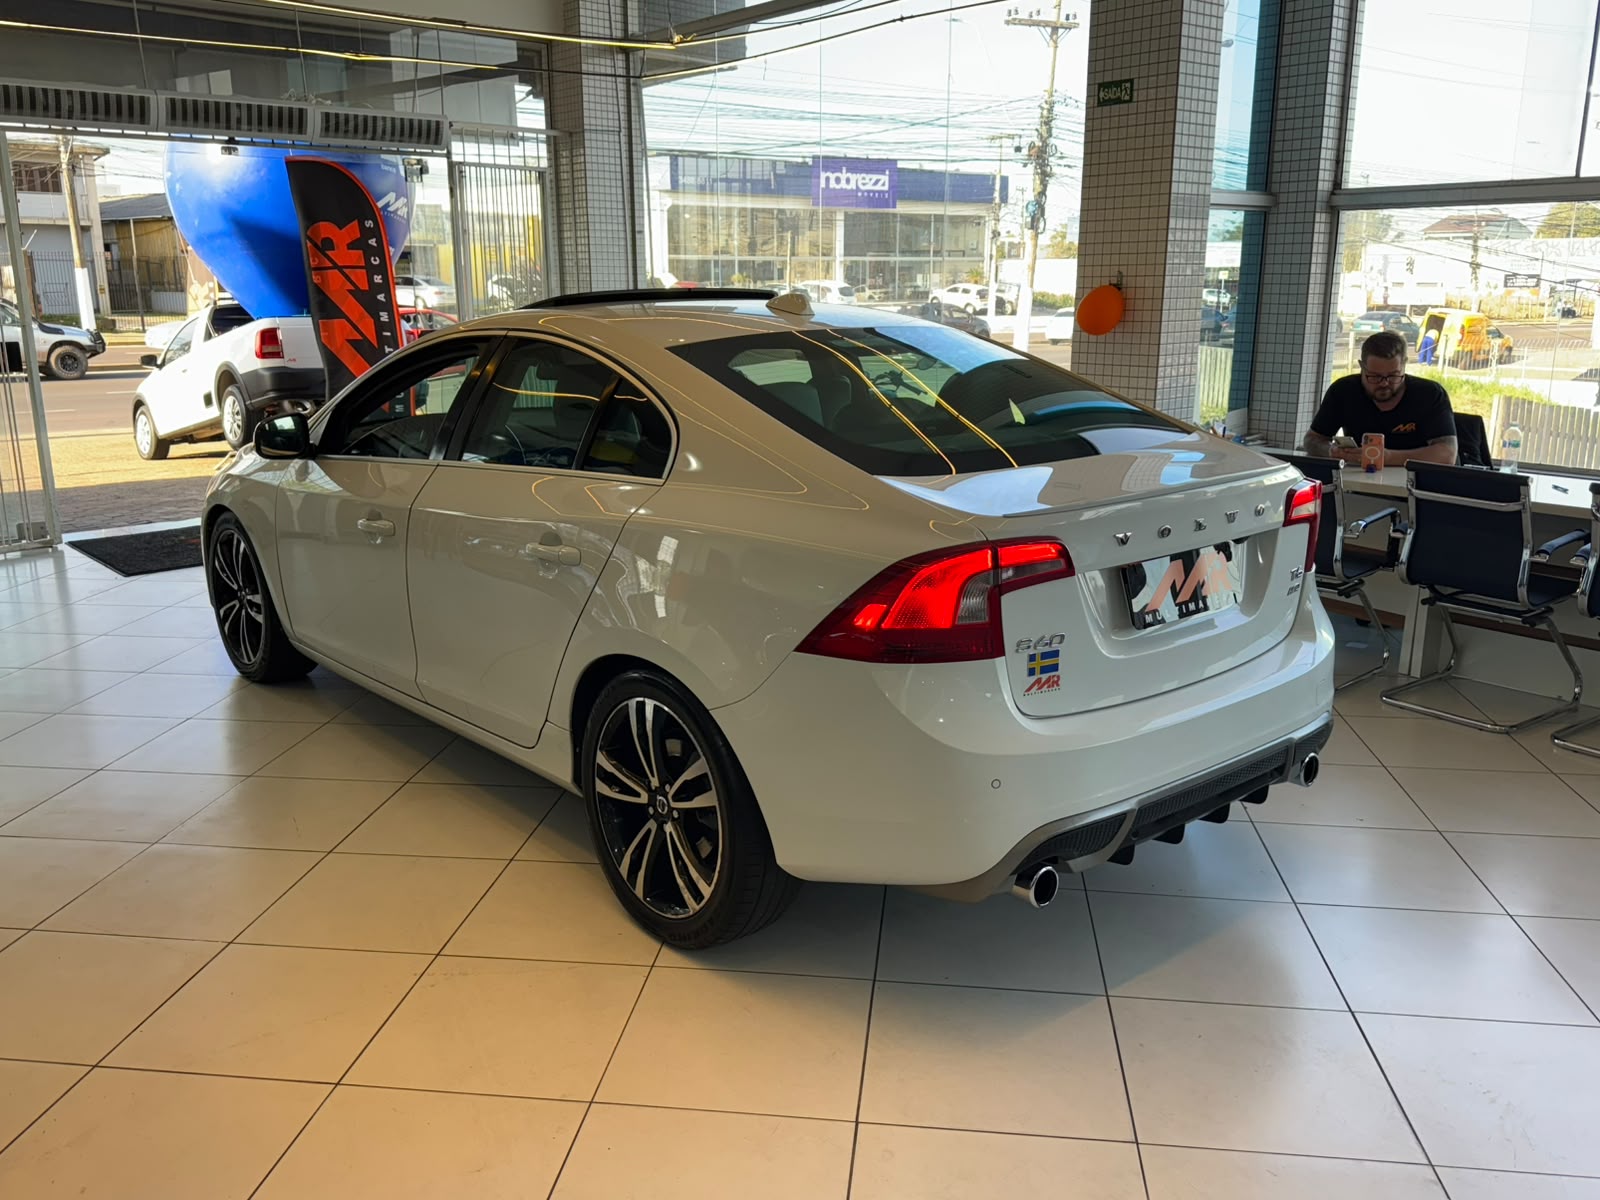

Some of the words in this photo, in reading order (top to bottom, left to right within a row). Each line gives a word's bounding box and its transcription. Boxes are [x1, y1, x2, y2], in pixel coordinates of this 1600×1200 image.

[821, 167, 889, 190] nobrezzi
[1114, 504, 1265, 546] VOLVO
[1015, 633, 1065, 653] S60
